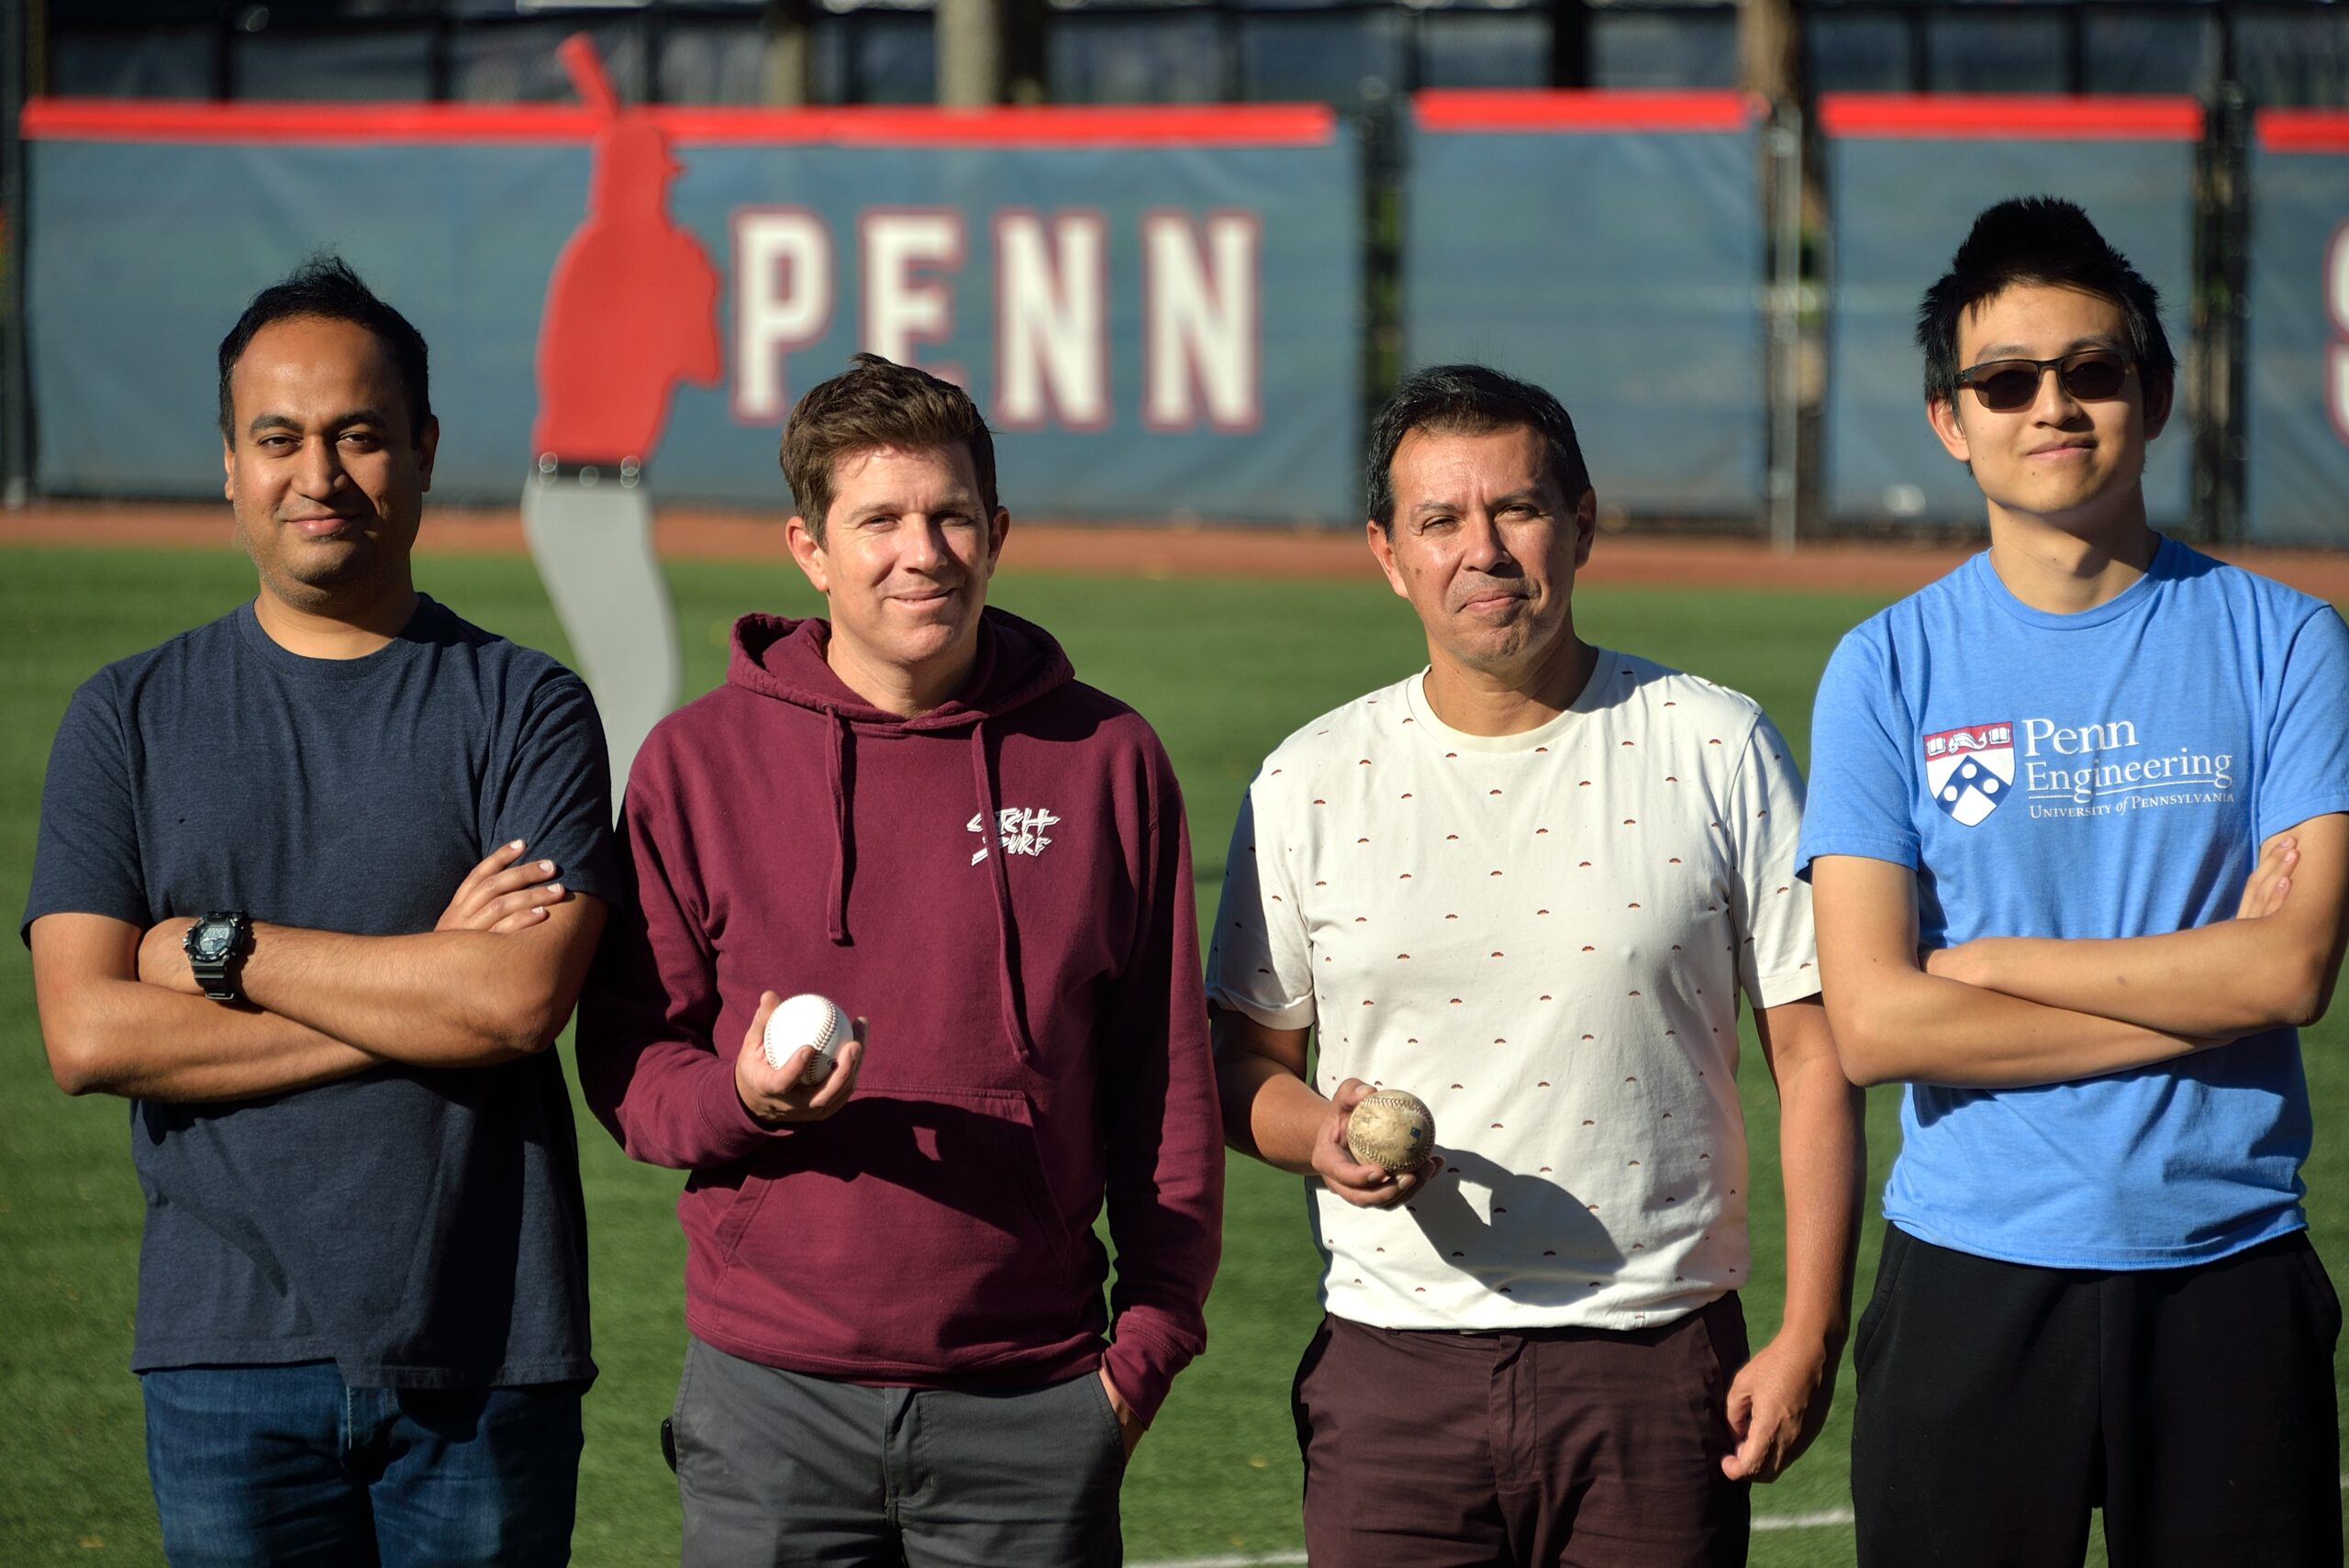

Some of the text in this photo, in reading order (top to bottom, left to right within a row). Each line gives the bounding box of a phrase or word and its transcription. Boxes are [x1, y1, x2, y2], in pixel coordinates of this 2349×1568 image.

[729, 205, 1259, 433] PENN
[2021, 717, 2140, 757] Penn
[2025, 747, 2233, 804] Engineering
[2028, 791, 2235, 819] UNIVERSITY of PENNSYLVANIA
